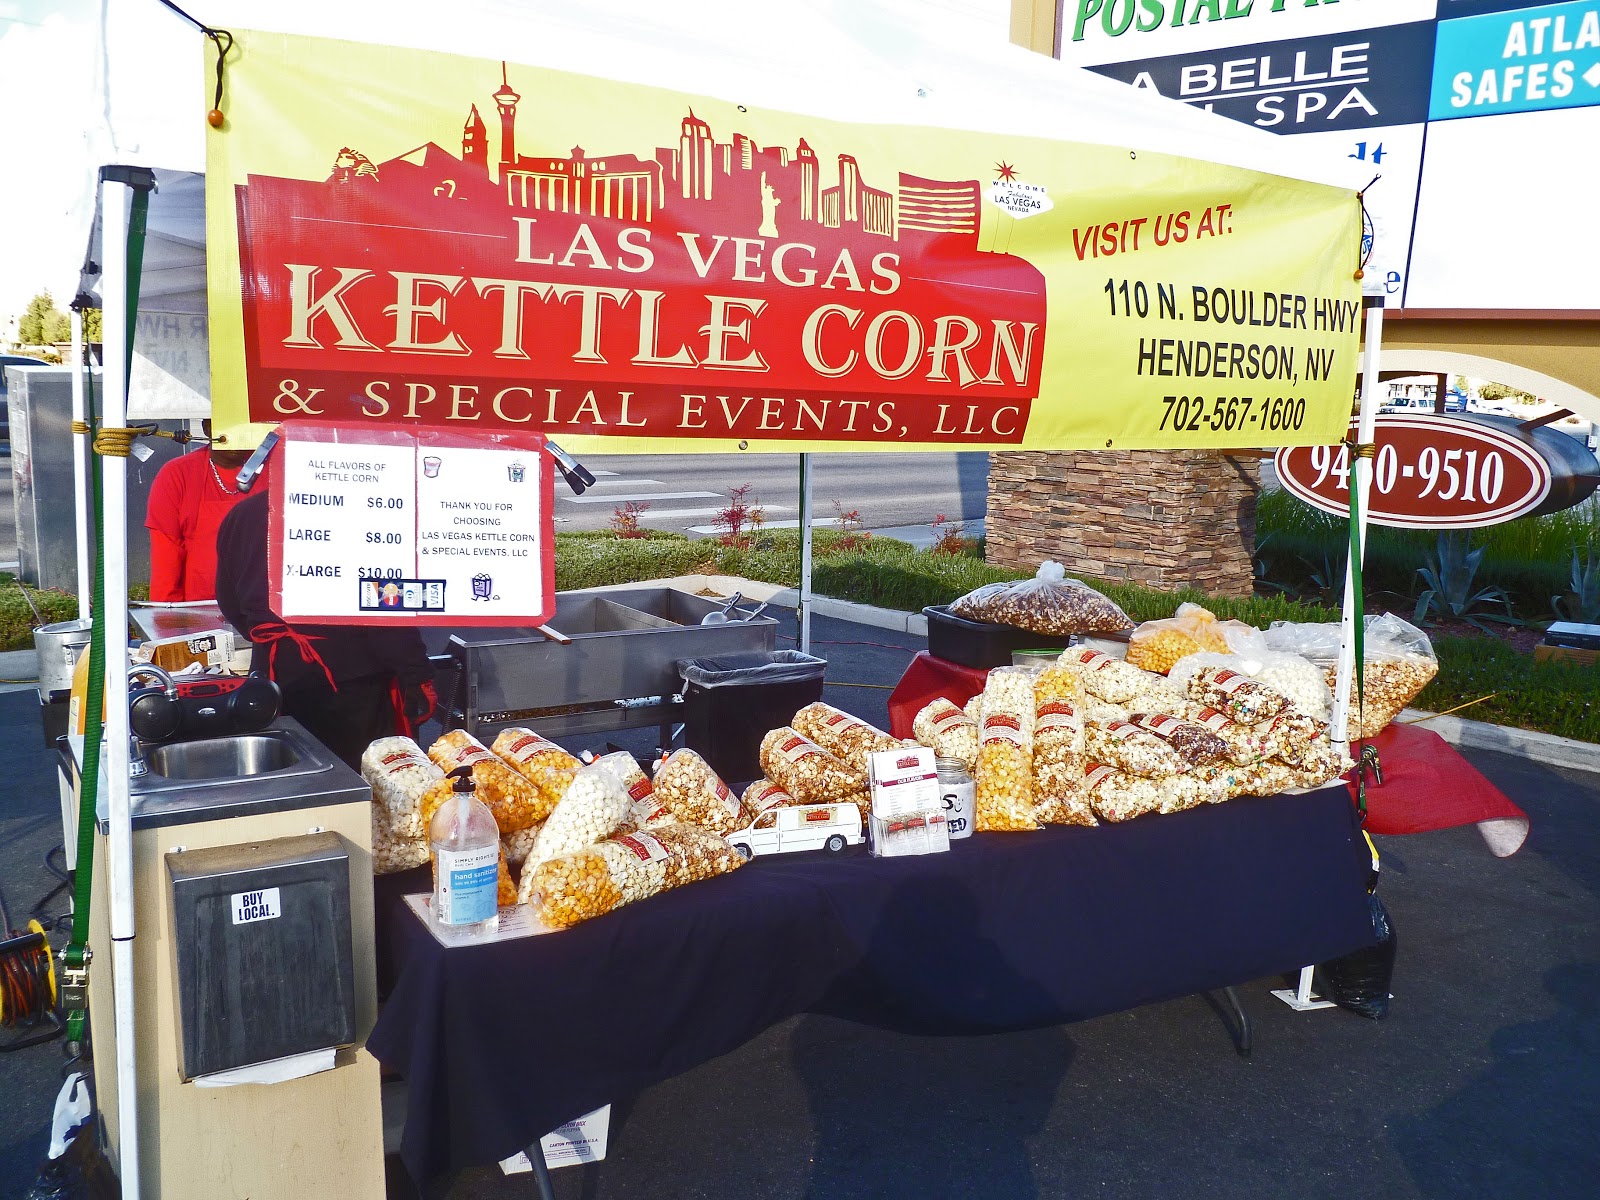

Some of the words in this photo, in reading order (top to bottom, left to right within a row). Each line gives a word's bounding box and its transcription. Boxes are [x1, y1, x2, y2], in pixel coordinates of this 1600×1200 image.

[1179, 42, 1370, 96] BELLE
[1450, 60, 1575, 108] SAFES
[1253, 87, 1379, 126] SPA
[992, 180, 1046, 193] WELCOME
[994, 195, 1010, 205] LAS
[1012, 197, 1041, 209] VEGAS
[1007, 205, 1029, 213] NEVADA
[1072, 217, 1148, 261] VISIT
[1153, 210, 1191, 247] US
[1196, 203, 1233, 239] AT:
[512, 216, 655, 273] LAS
[677, 231, 901, 295] VEGAS
[1104, 278, 1149, 318] 110
[1156, 282, 1184, 321] N.
[1191, 285, 1307, 329] BOULDER
[1314, 297, 1360, 333] HWY
[281, 262, 771, 373] KETTLE
[801, 303, 1040, 389] CORN
[1137, 337, 1298, 387] HENDERSON,
[1305, 347, 1335, 381] NV
[271, 378, 325, 415] &
[361, 380, 648, 427] SPECIAL
[676, 394, 910, 438] EVENTS,
[932, 403, 1020, 436] LLC
[1159, 395, 1306, 431] 702-567-1600
[308, 460, 326, 470] ALL
[328, 460, 371, 471] FLAVORS
[374, 462, 386, 472] OF
[1310, 445, 1504, 504] 940-9510
[315, 472, 350, 482] KETTLE
[352, 473, 379, 483] CORN
[288, 493, 344, 507] MEDIUM
[367, 496, 403, 510] $6.00
[440, 501, 471, 511] THANK
[474, 502, 493, 511] YOU
[495, 502, 513, 512] FOR
[453, 516, 501, 526] CHOOSING
[288, 528, 331, 541] LARGE
[365, 532, 402, 545] $8.00
[422, 531, 440, 541] LAS
[442, 532, 473, 541] VEGAS
[475, 532, 507, 542] KETTLE
[509, 533, 535, 542] CORN
[422, 546, 430, 555] &
[432, 547, 470, 556] SPECIAL
[512, 548, 528, 557] LLC
[286, 564, 342, 578] X-LARGE
[358, 567, 403, 579] $10.00
[430, 583, 439, 606] VISA
[473, 867, 498, 878] sanitizer
[242, 892, 263, 908] BUY
[238, 904, 275, 921] LOCAL.
